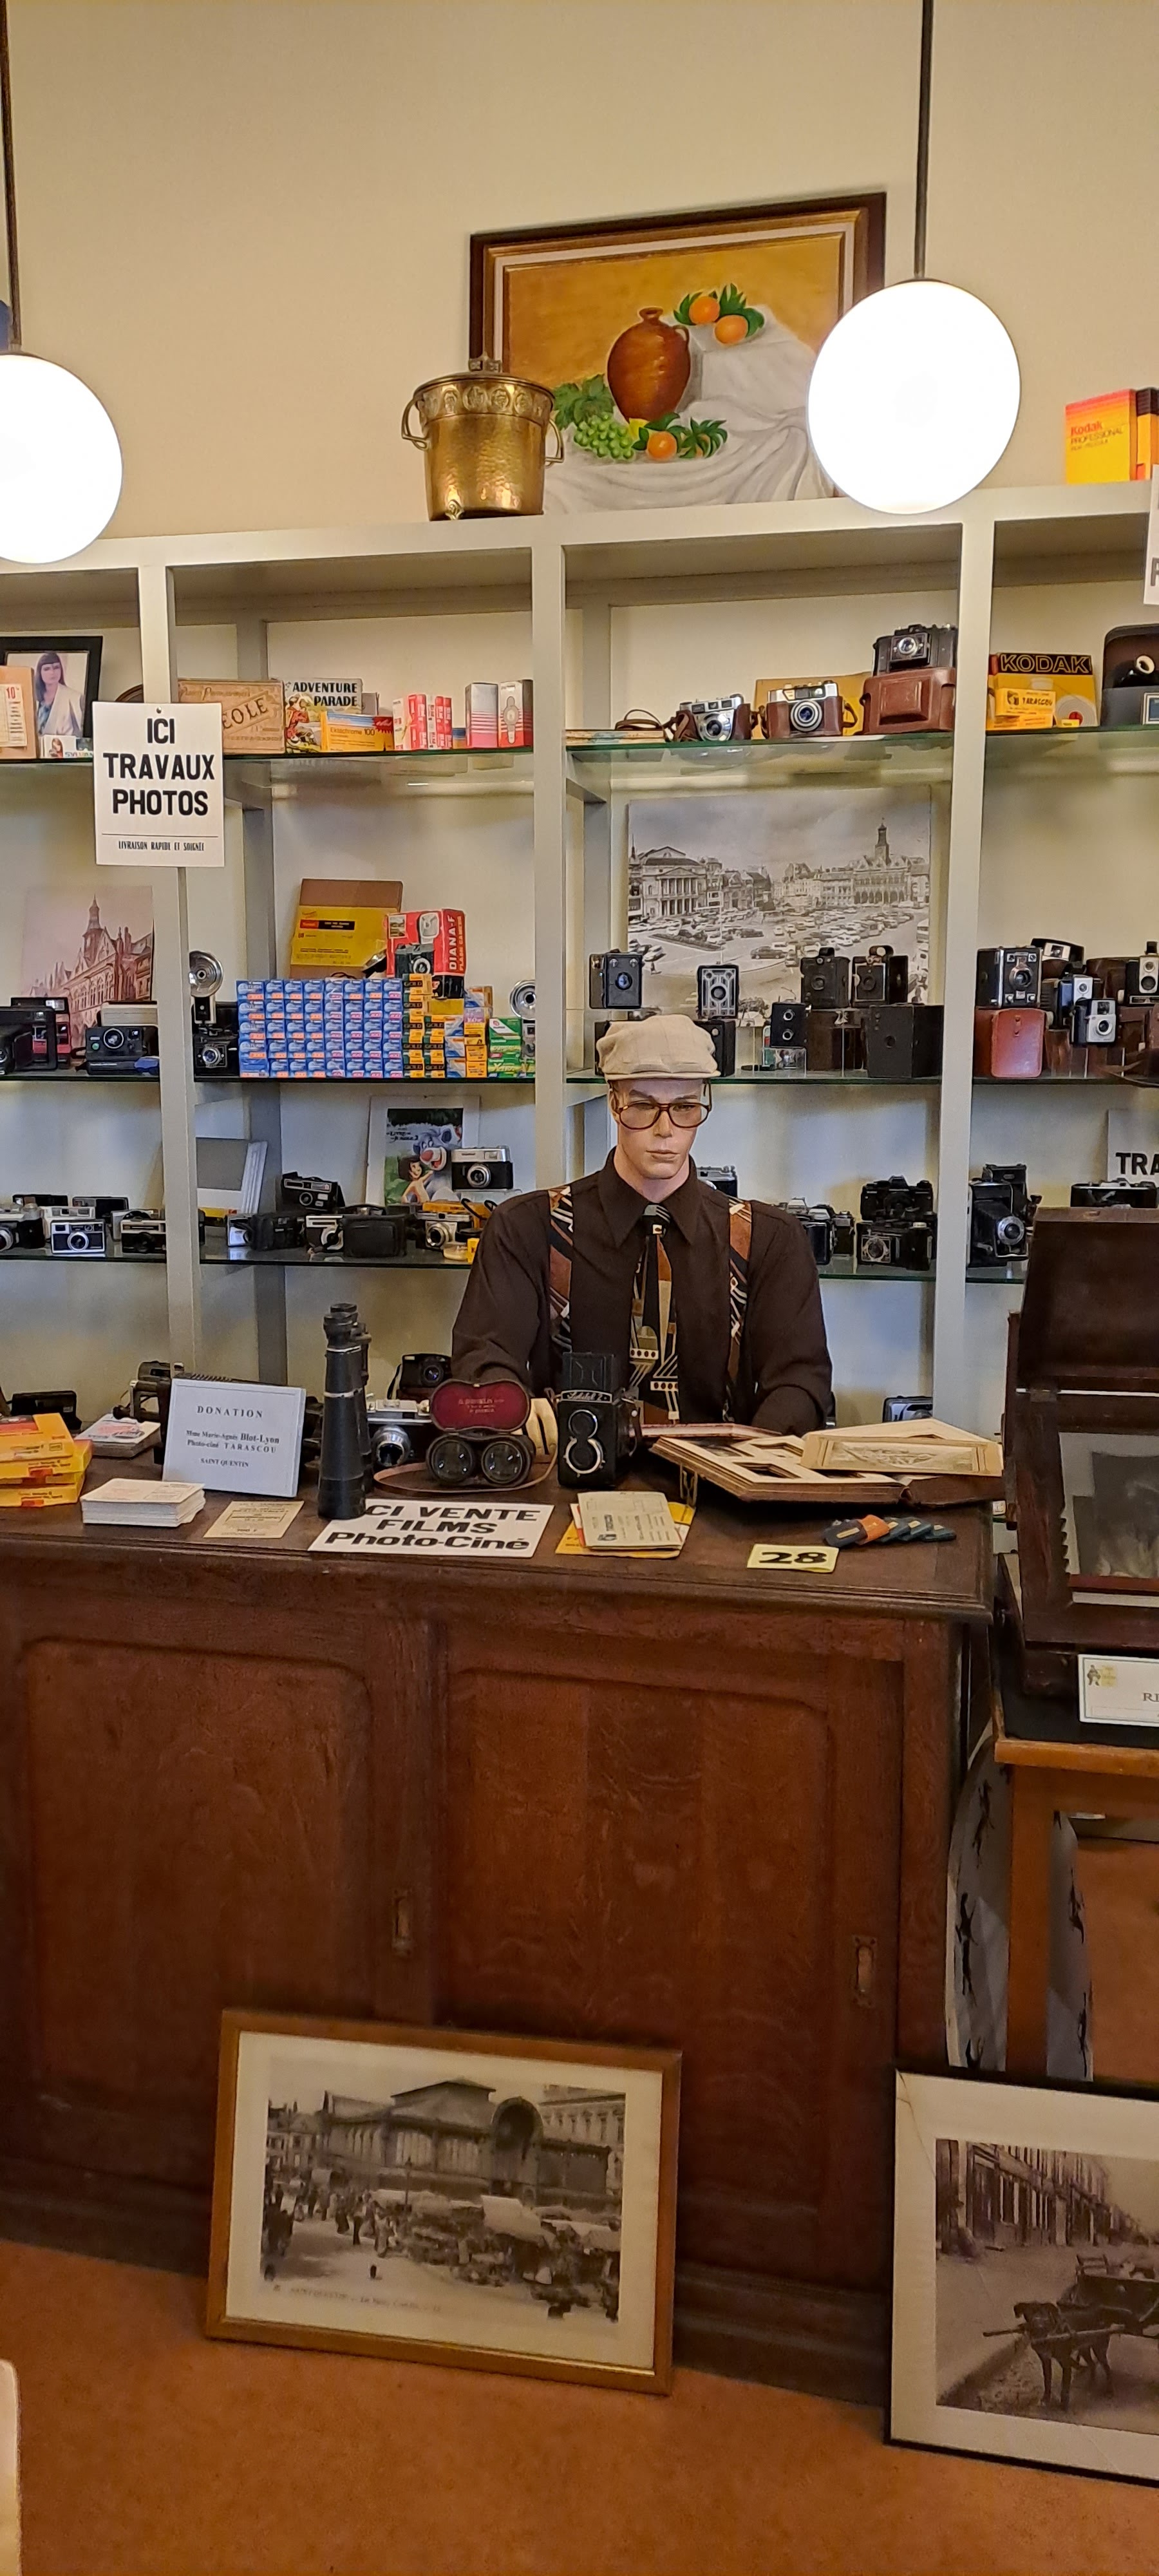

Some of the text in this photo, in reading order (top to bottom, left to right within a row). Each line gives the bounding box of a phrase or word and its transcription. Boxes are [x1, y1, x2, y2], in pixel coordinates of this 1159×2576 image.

[1071, 421, 1102, 435] Kodak
[1000, 654, 1089, 673] KODAK
[292, 681, 357, 693] ADVENTURE
[314, 696, 357, 706] PARADE
[147, 718, 174, 744] ICI
[330, 726, 363, 735] Ektachrome
[103, 752, 215, 780] TRAVAUX
[113, 788, 208, 815] PHOTOS
[118, 840, 147, 849] LIVRAISON
[151, 841, 171, 850] RAPIDE
[174, 842, 180, 850] ET
[447, 914, 457, 970] DIANA-F
[197, 1405, 263, 1418] DONATION
[240, 1433, 279, 1445] Blot-Lyon
[224, 1443, 277, 1454] TARASCOU
[220, 1459, 249, 1468] QUENTIN
[365, 1504, 541, 1521] CI VENTE
[376, 1519, 498, 1533] FILMS
[325, 1531, 530, 1549] Photo-Ciné
[759, 1551, 827, 1564] 28
